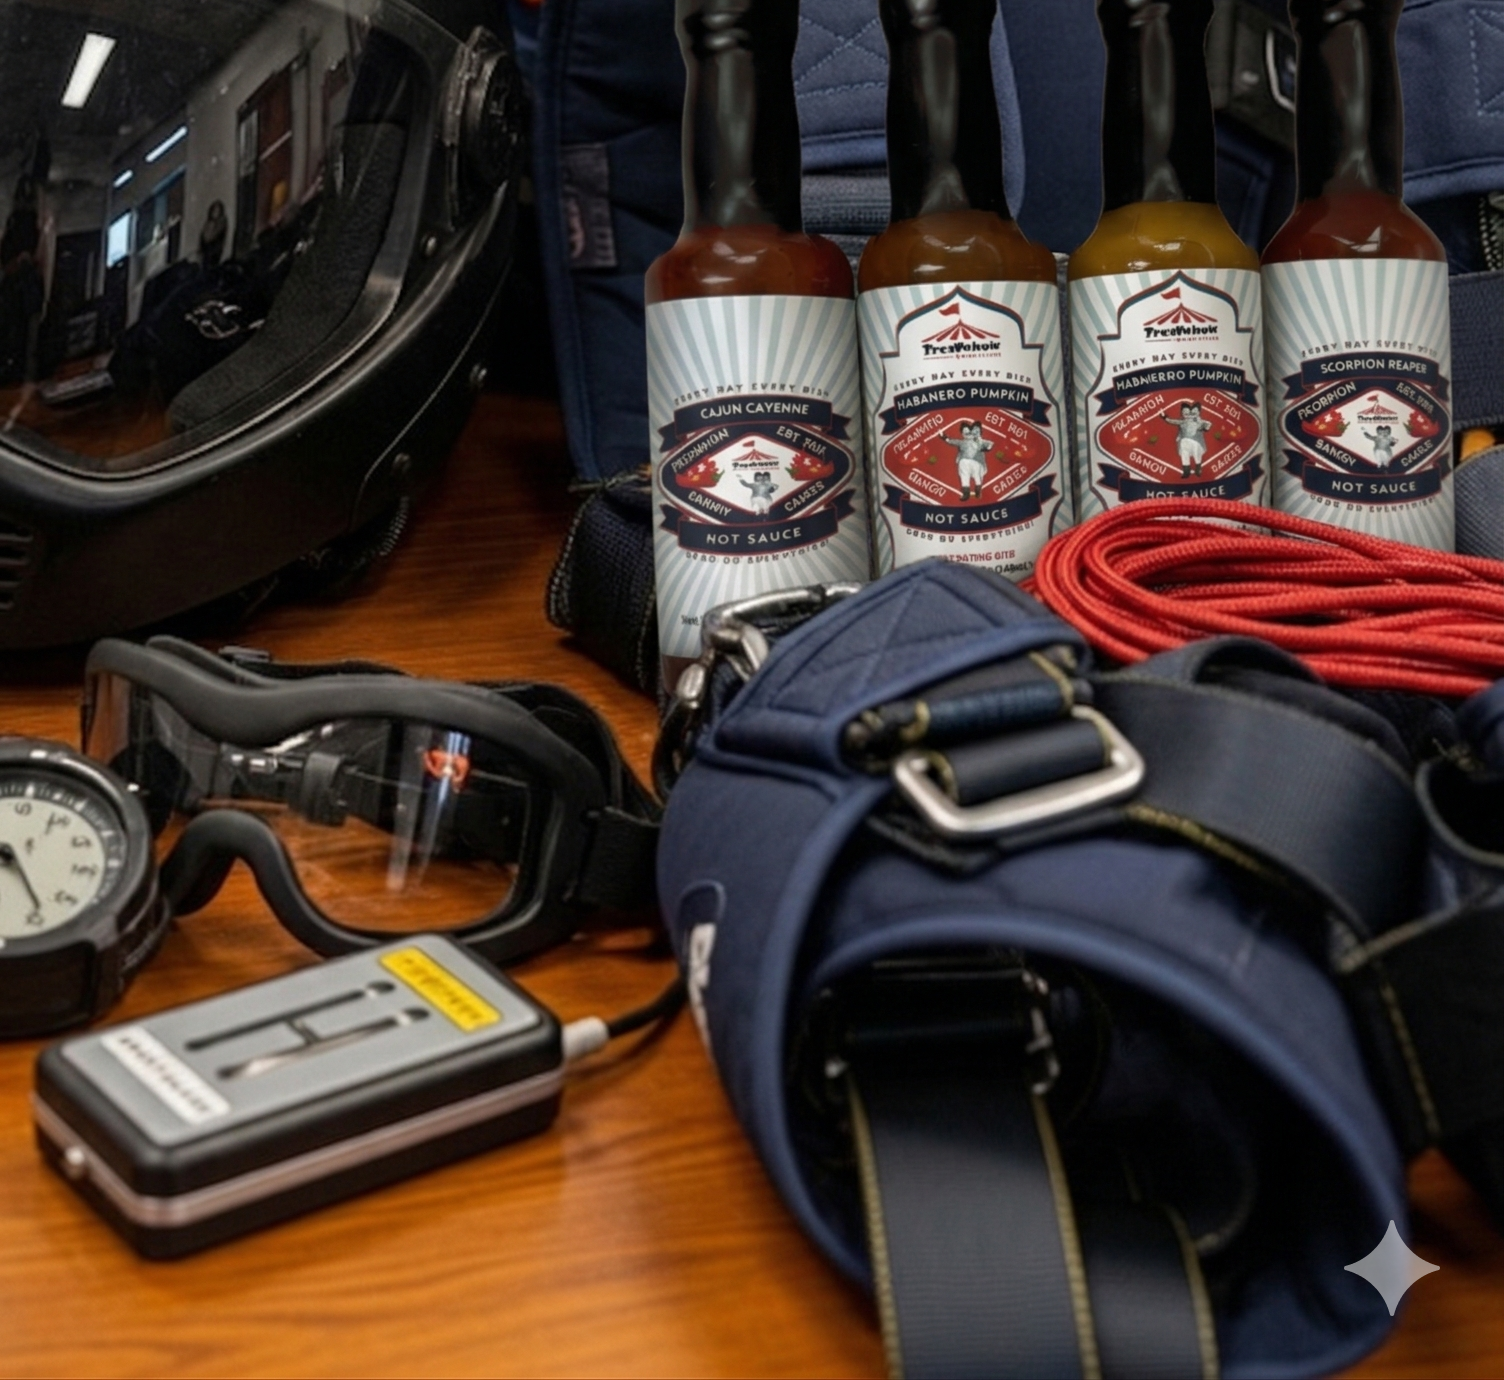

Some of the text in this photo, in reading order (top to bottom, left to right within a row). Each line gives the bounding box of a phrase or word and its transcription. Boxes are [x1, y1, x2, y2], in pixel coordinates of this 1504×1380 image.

[1321, 359, 1427, 374] SCORPION REAPER
[1189, 369, 1242, 385] PUMPKIN
[897, 388, 1030, 411] HABANERO PUMPKIN
[700, 402, 809, 419] CAJUN CAYENNE
[1181, 485, 1226, 499] SAUCE
[1370, 481, 1416, 494] SAUCE
[925, 513, 954, 524] NOT
[747, 527, 802, 545] SAUCE
